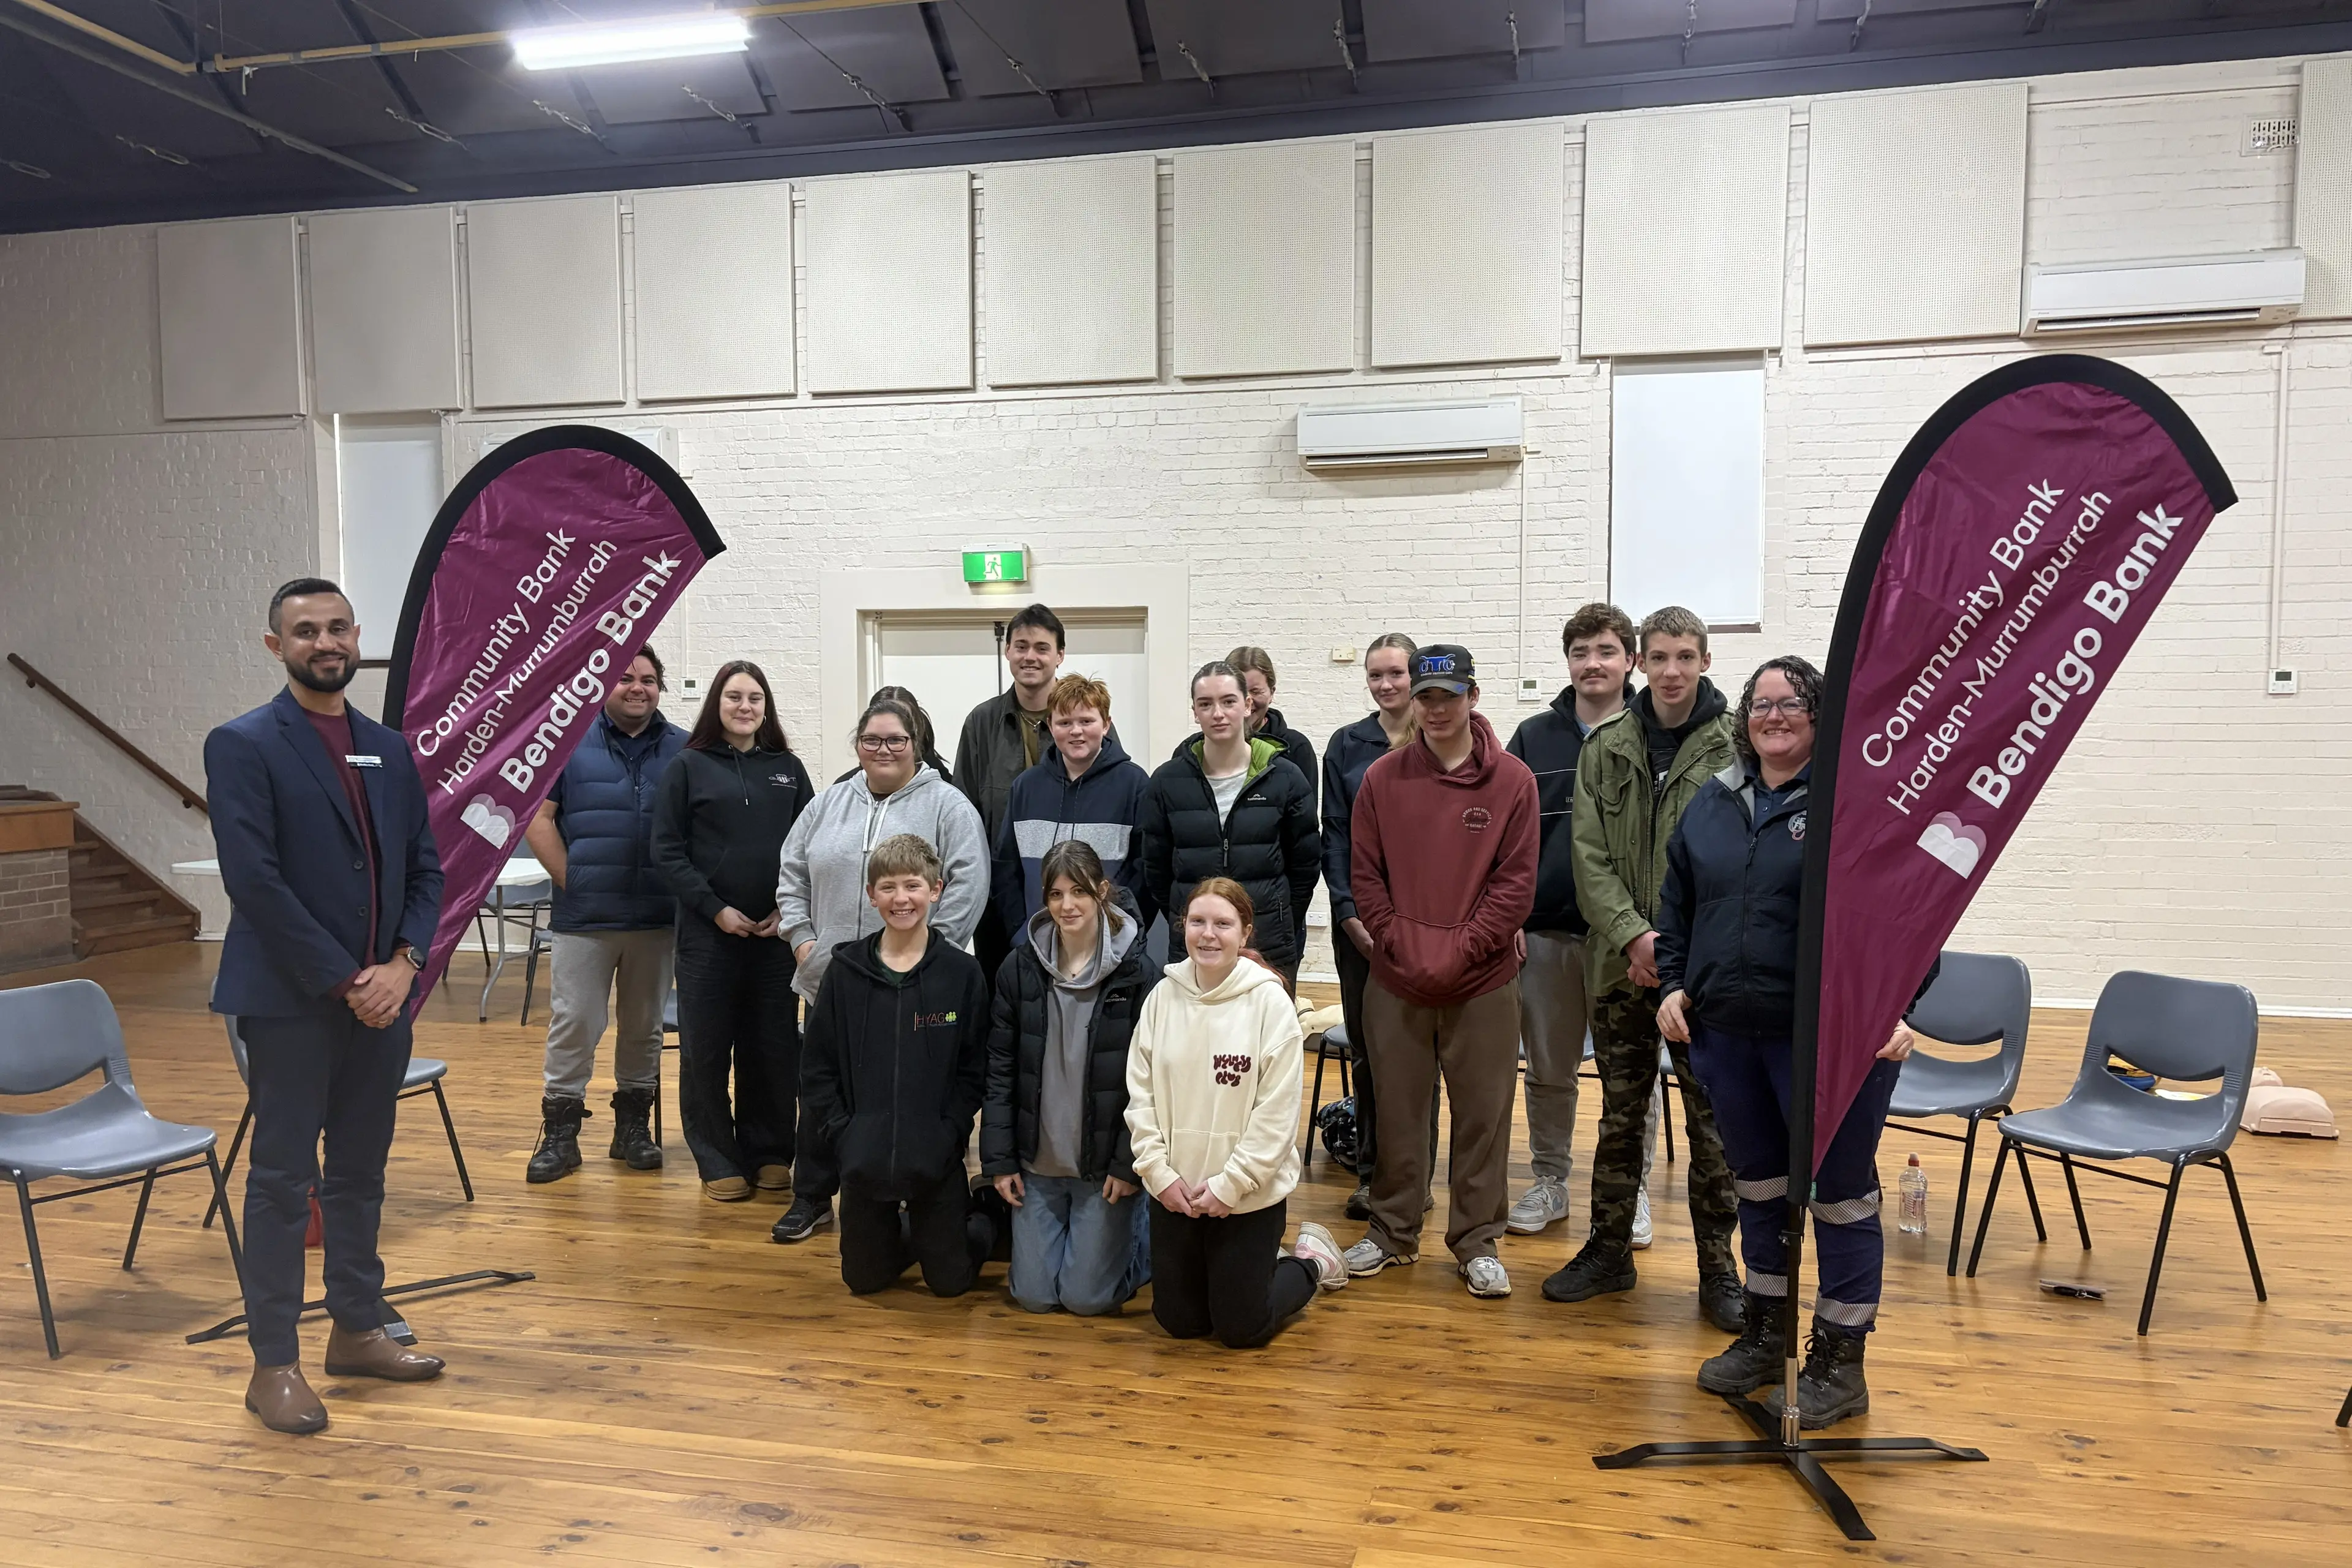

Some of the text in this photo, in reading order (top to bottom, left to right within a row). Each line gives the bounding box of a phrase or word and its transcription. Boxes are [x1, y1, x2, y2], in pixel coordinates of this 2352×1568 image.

[417, 527, 576, 756] Community Bank
[437, 540, 617, 795] Harden-Murrumburrah
[498, 648, 610, 794] Bendigo
[595, 549, 682, 647] Bank
[1862, 478, 2065, 767] Community Bank
[1887, 492, 2112, 815] Harden-Murrumburrah
[1966, 627, 2101, 809] Bendigo
[2082, 503, 2184, 624] Bank
[916, 1012, 945, 1024] HYAG
